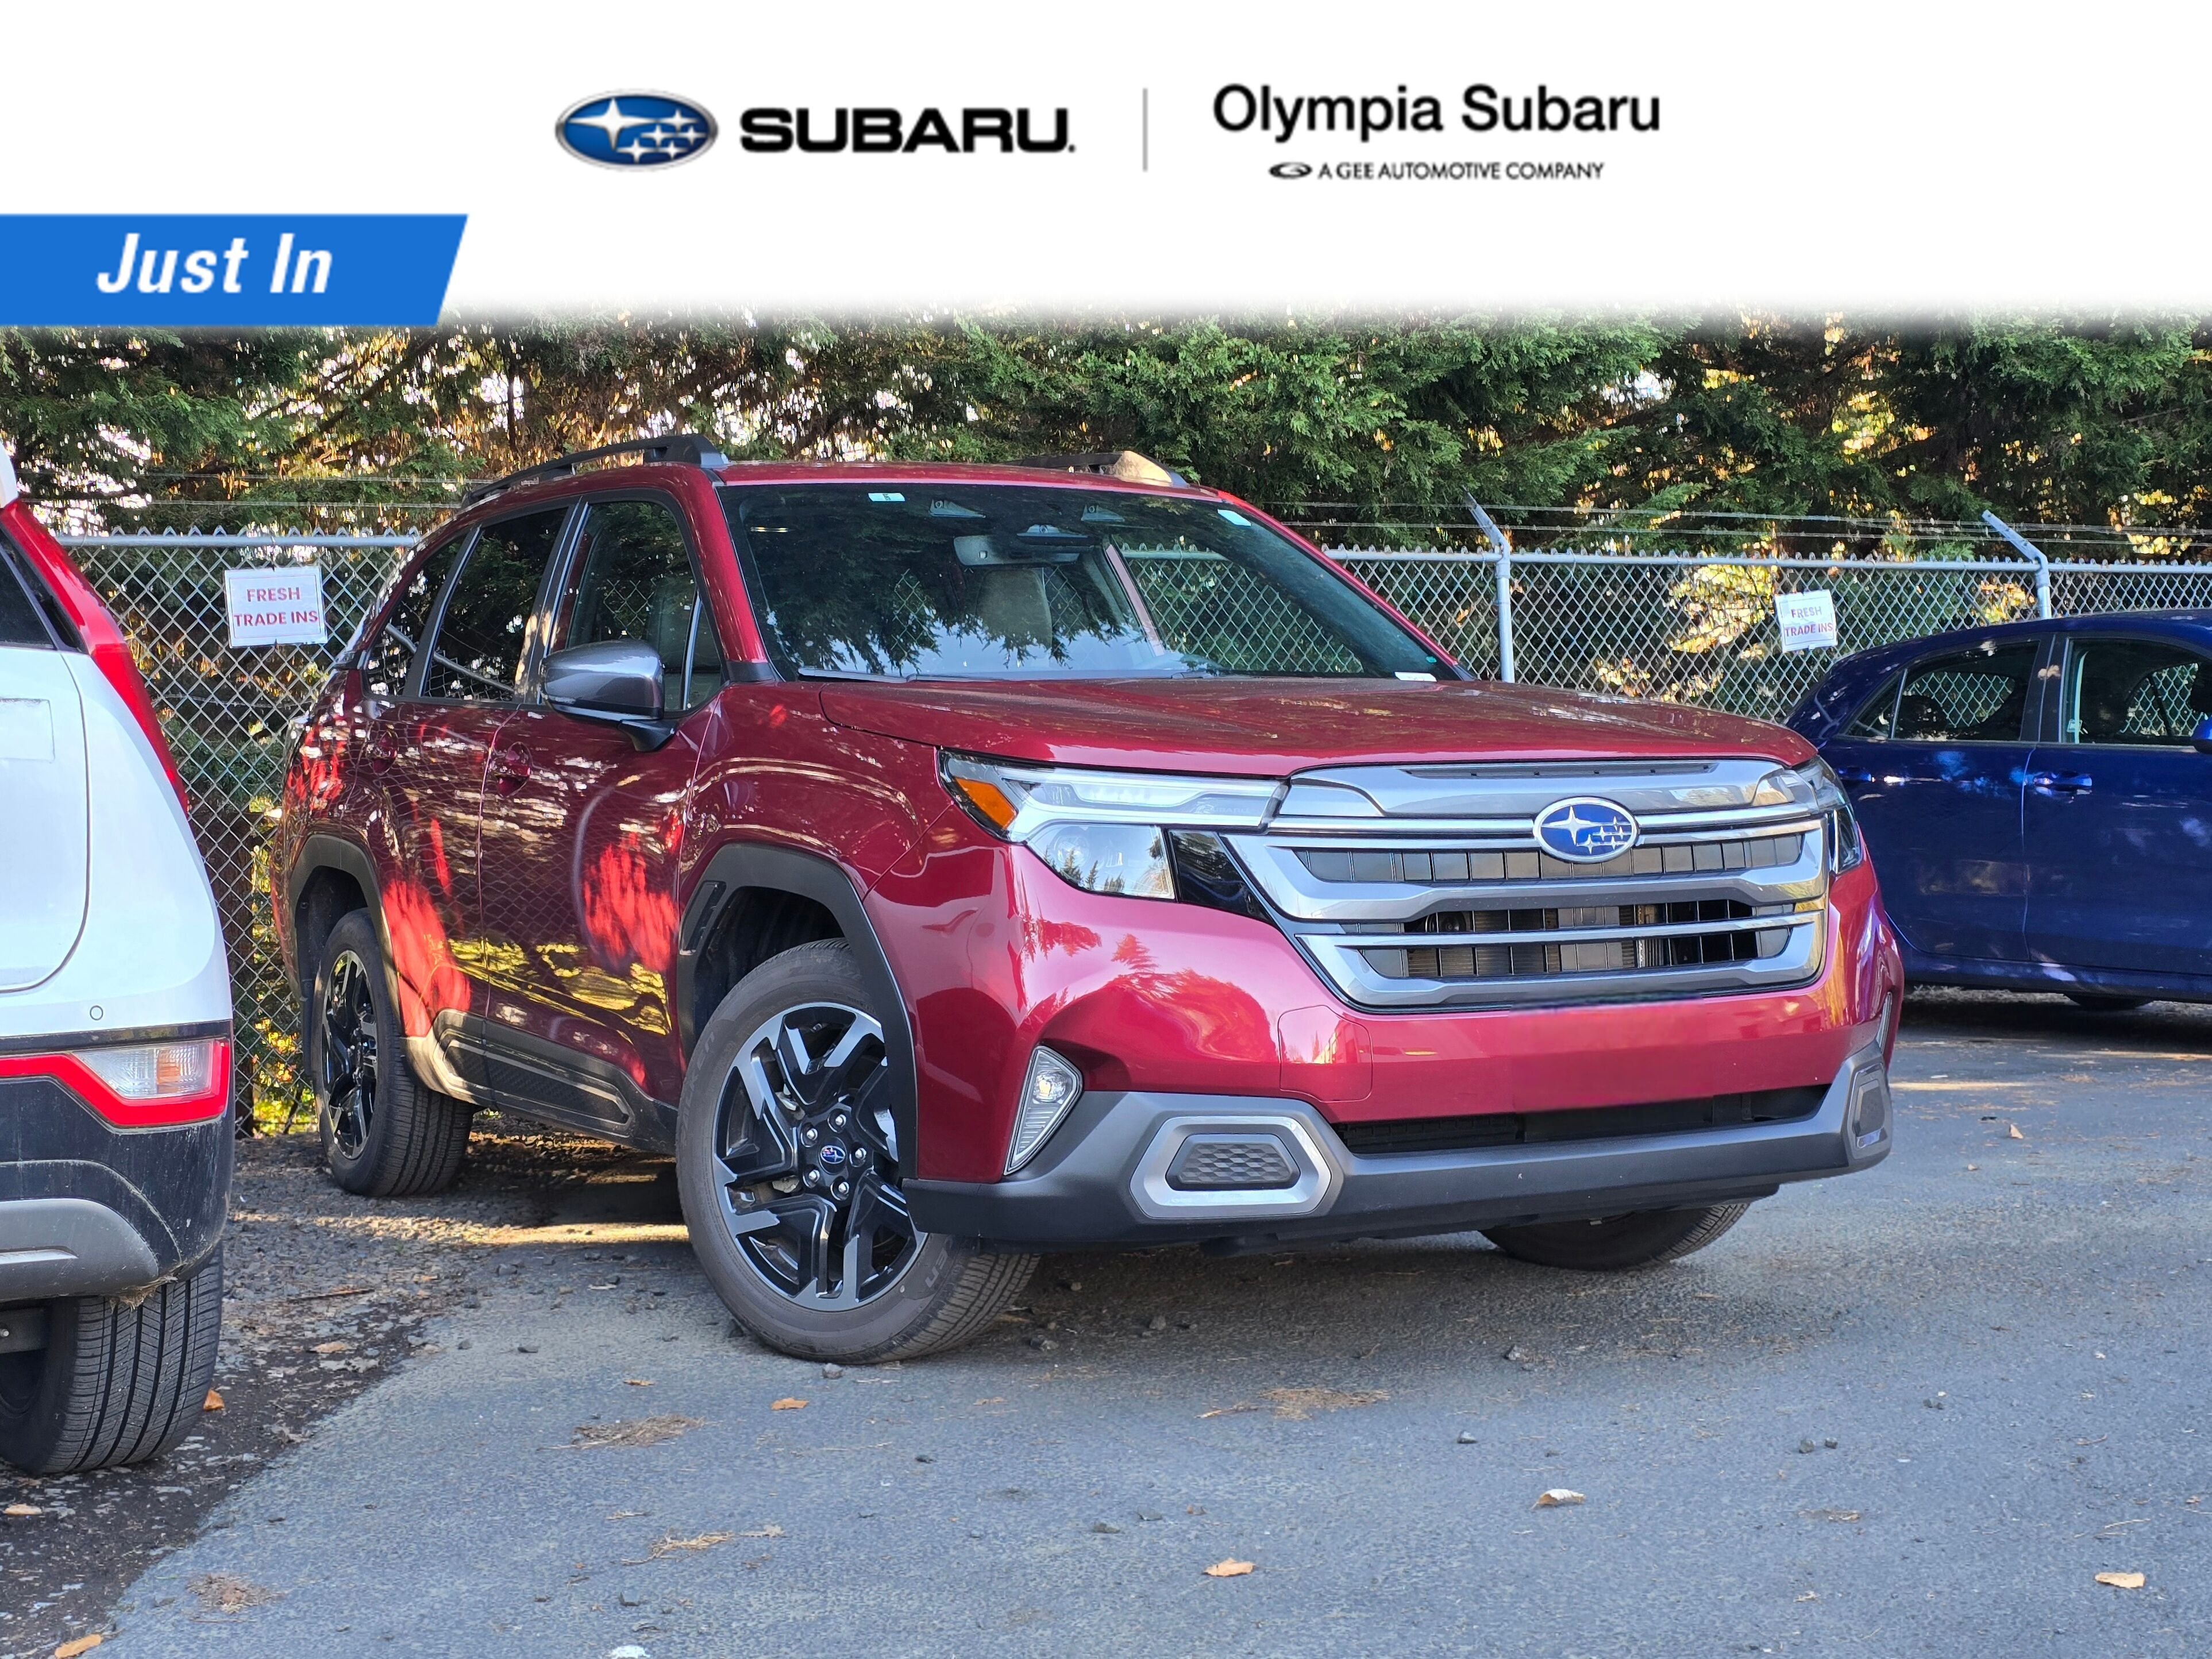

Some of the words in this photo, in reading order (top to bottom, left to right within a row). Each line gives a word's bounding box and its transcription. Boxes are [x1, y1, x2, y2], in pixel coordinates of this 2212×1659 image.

[246, 587, 300, 603] FRESH
[234, 612, 287, 627] TRADE
[291, 610, 318, 624] INS
[1791, 606, 1822, 618] FRESH
[1785, 624, 1816, 636] TRADE
[1818, 622, 1833, 633] INS
